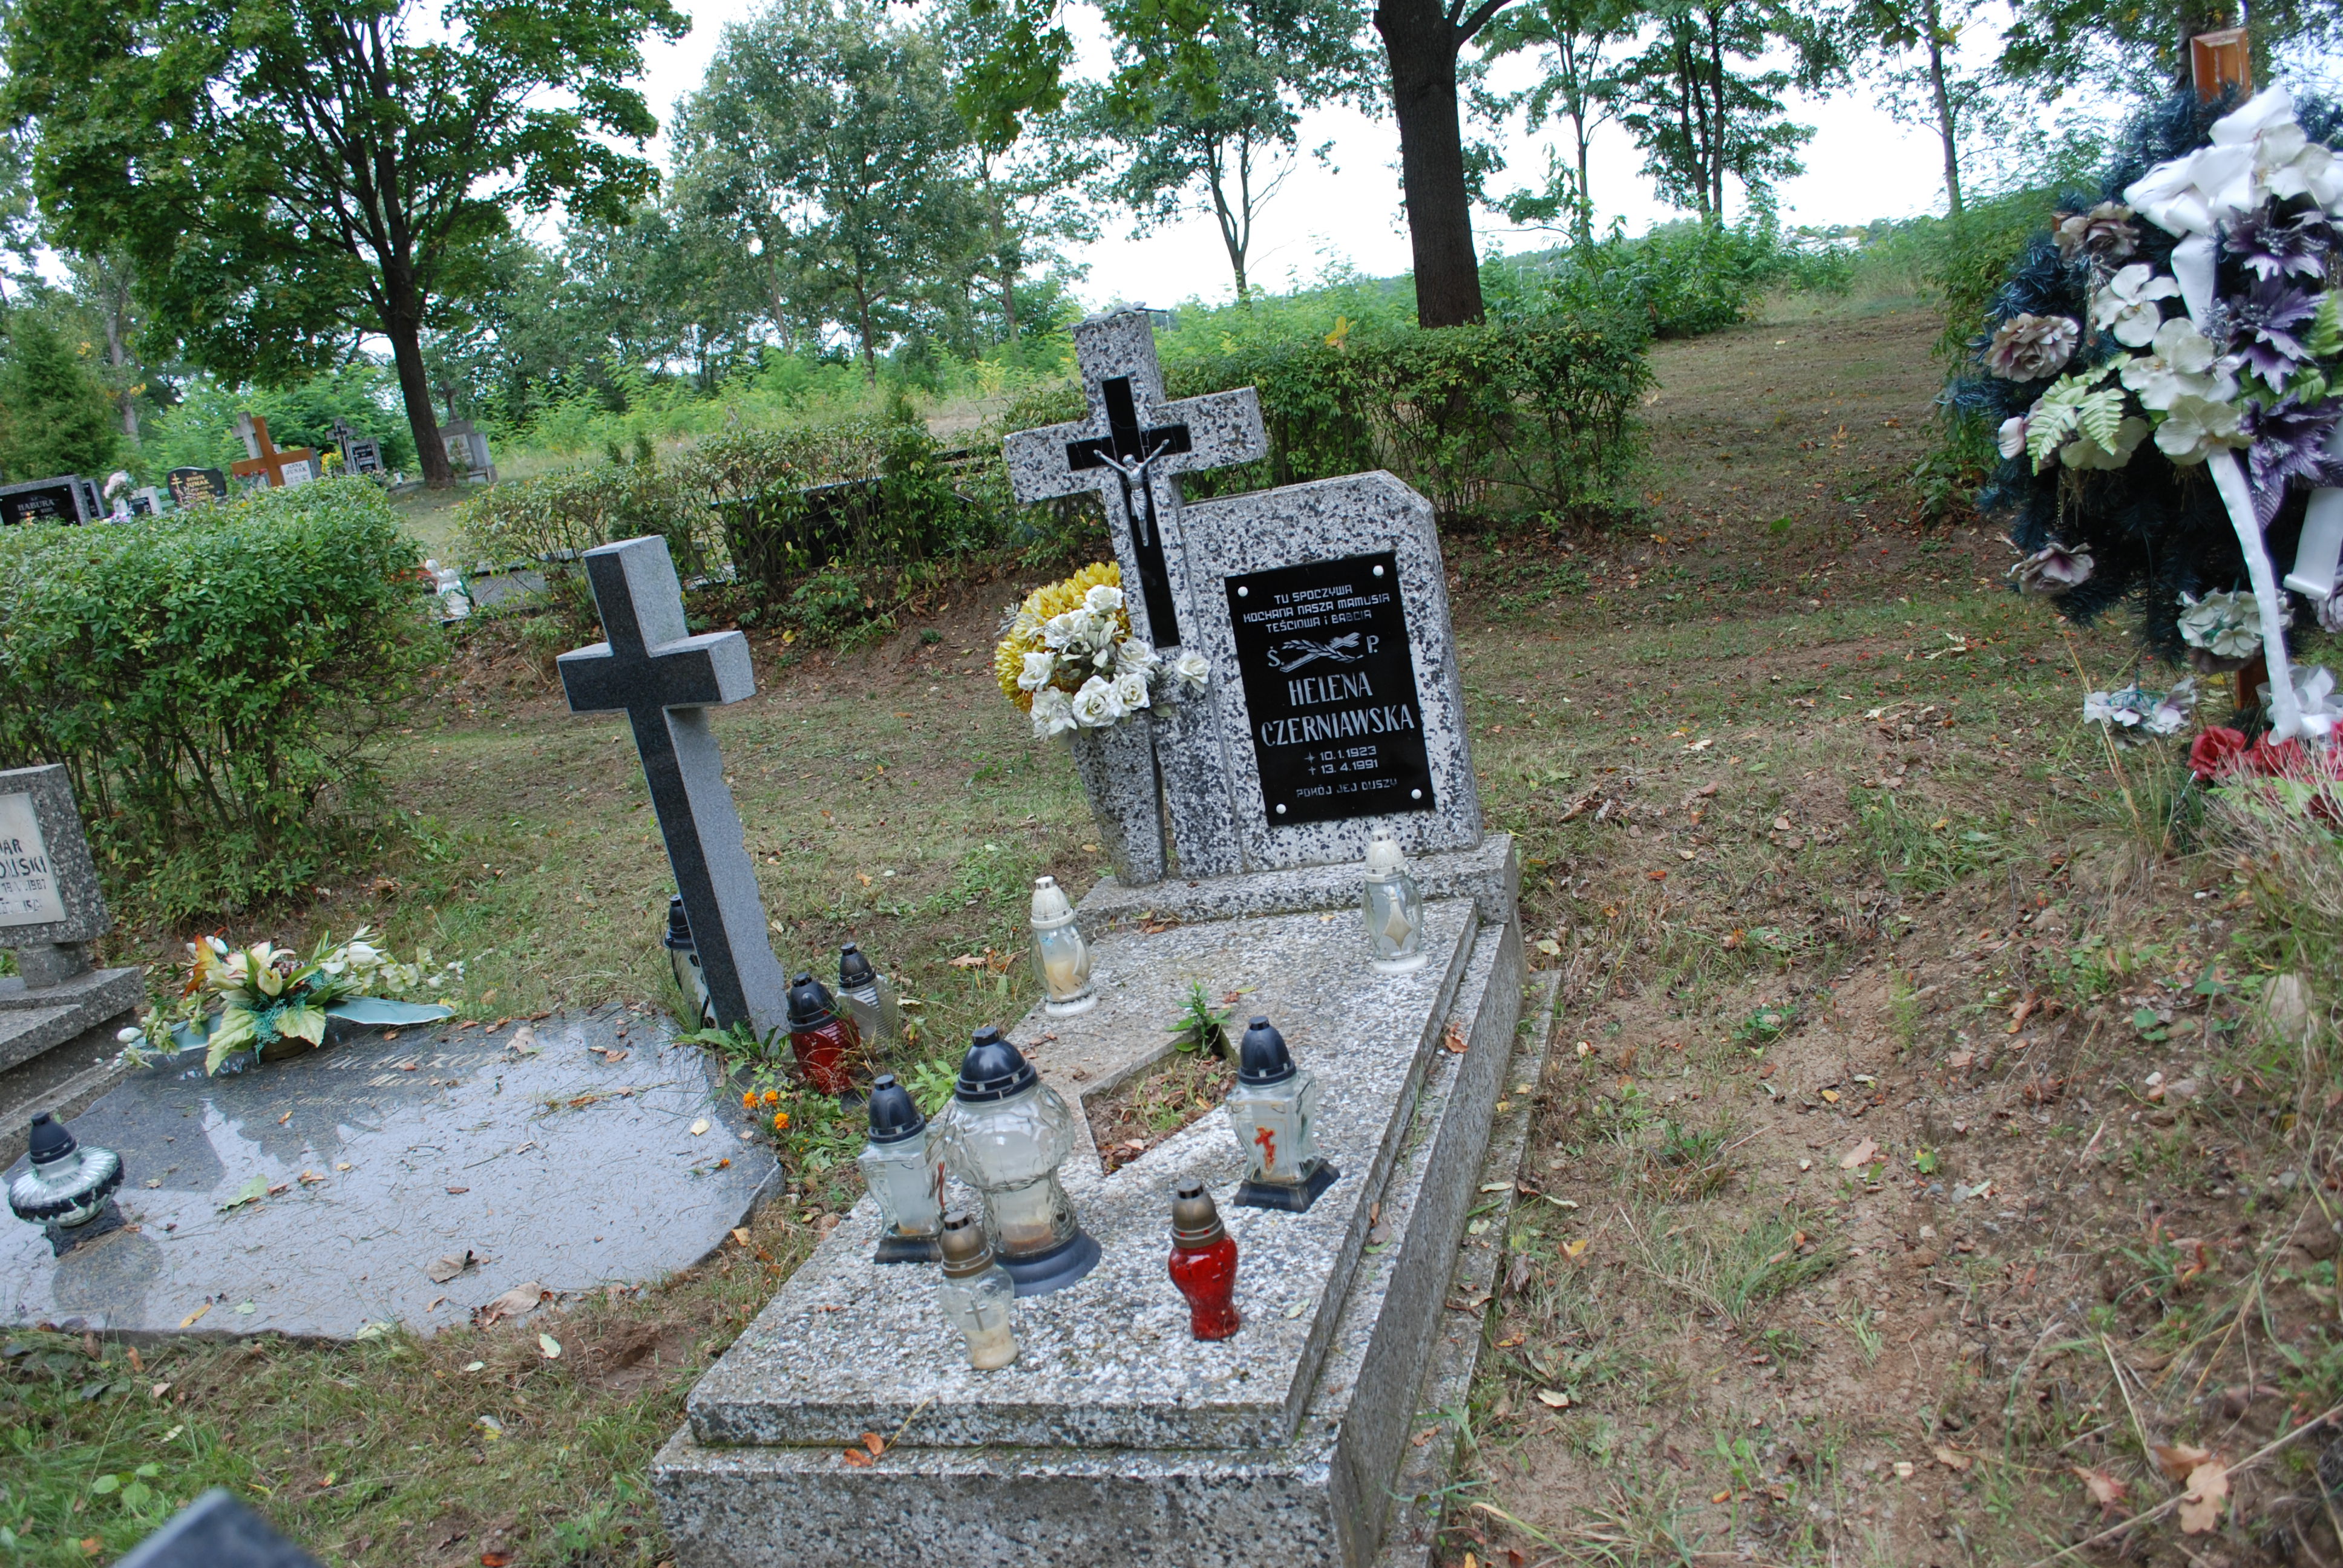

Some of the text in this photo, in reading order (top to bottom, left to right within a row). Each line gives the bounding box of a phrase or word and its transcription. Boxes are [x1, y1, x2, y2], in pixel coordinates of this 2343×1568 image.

[17, 499, 55, 511] HABURA
[1274, 584, 1353, 604] TU SPOCZYWA
[1243, 593, 1391, 623] KOCHANA NASZA MAMUSIA
[1265, 609, 1372, 633] TEŚCIOWA i BABCIA
[1366, 635, 1380, 653] P.
[1288, 671, 1373, 706] HELENA
[1261, 704, 1415, 746] CZERNIAWSKA
[1296, 778, 1397, 797] POKÓJ JEJ DUSZY
[0, 838, 23, 855] AR
